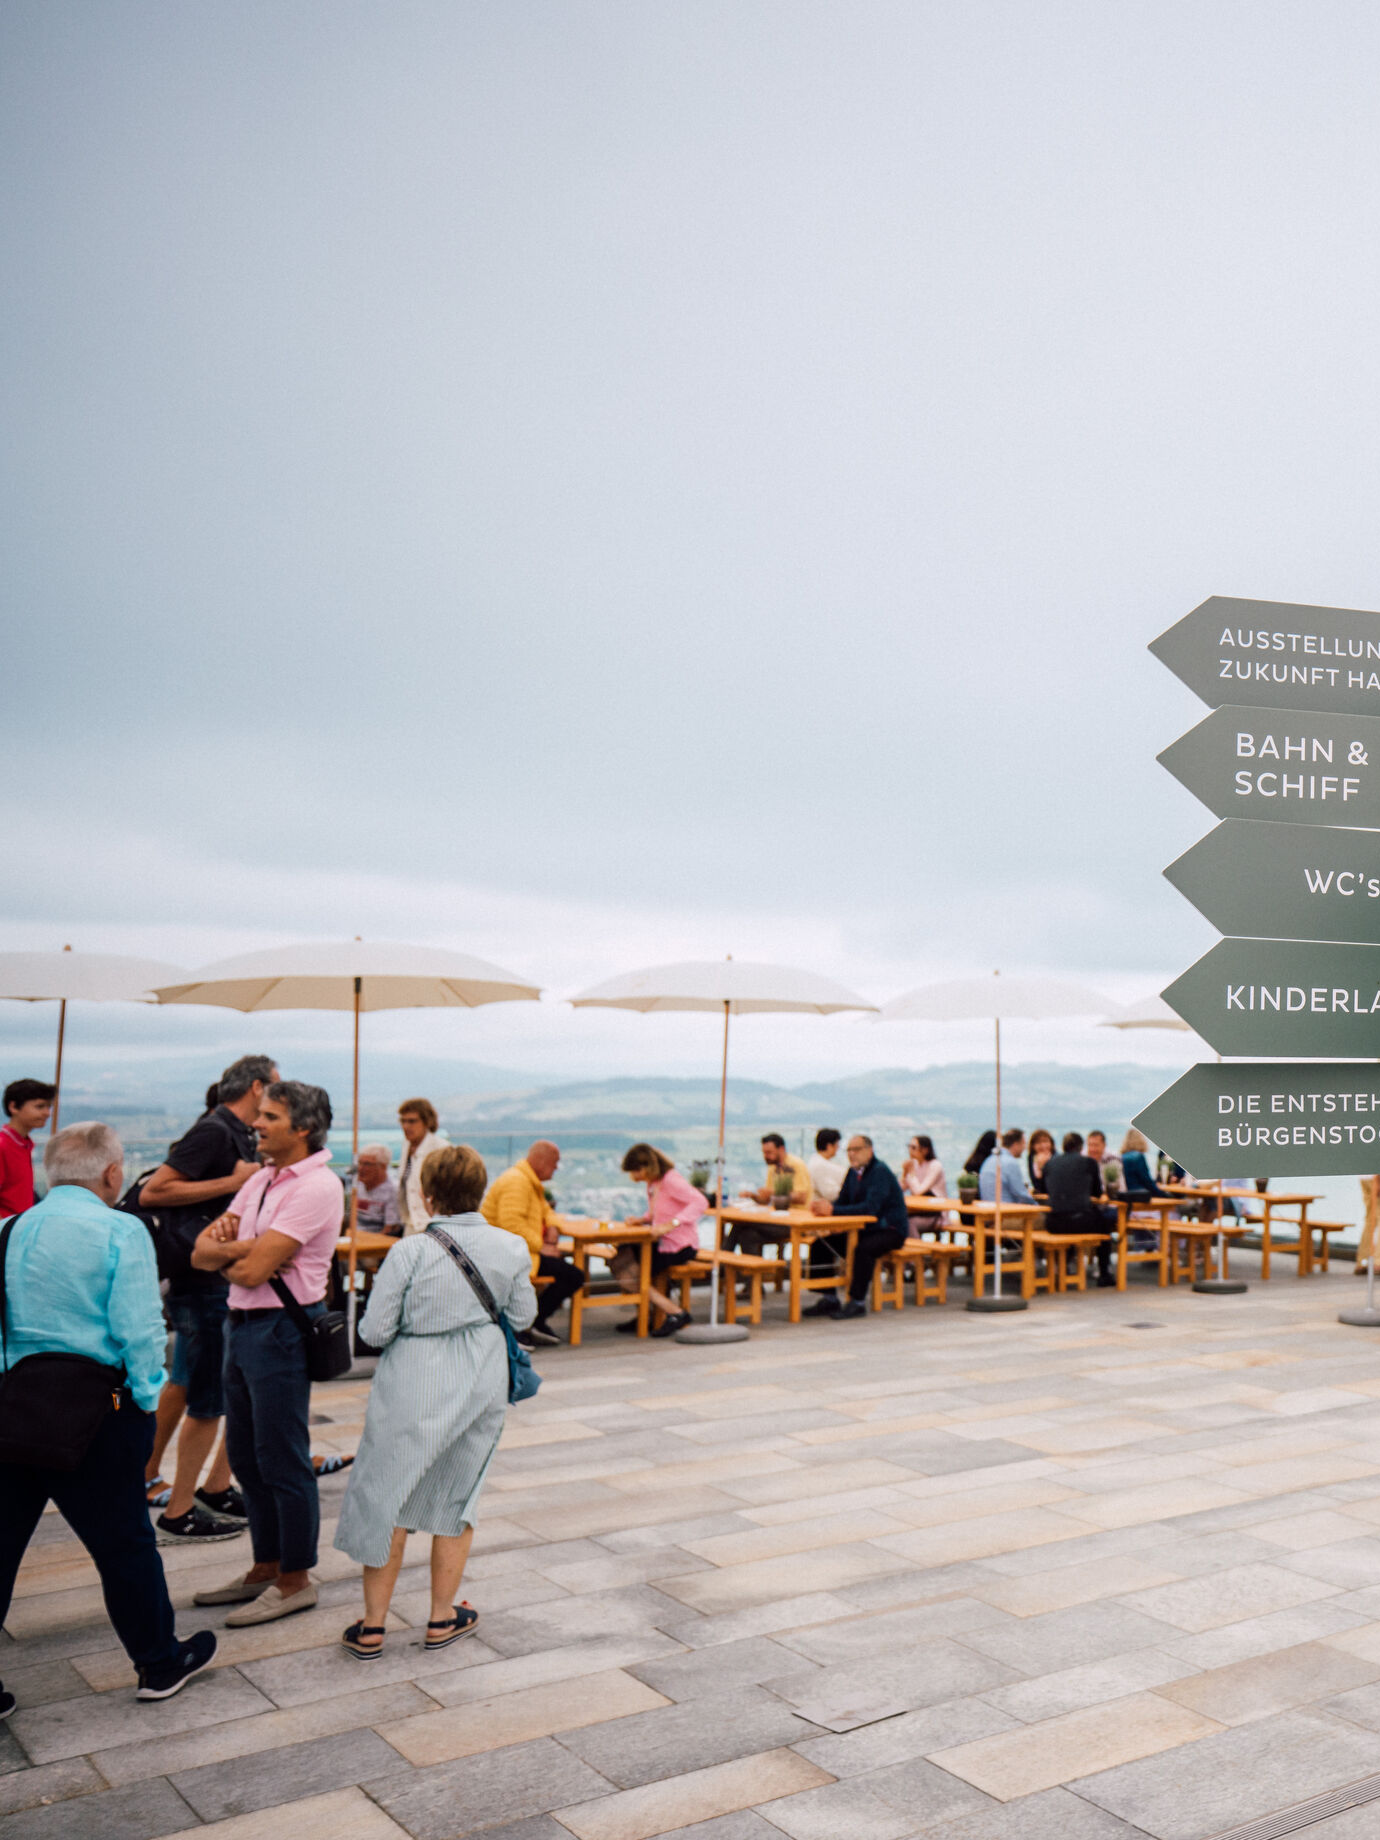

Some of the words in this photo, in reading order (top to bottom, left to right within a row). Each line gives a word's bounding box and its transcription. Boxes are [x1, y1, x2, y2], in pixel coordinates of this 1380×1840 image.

[1219, 659, 1340, 687] ZUKUNFT
[1236, 732, 1334, 764] BAHN
[1347, 741, 1369, 766] &
[1235, 770, 1361, 802] SCHIFF
[1217, 1095, 1262, 1114] DIE
